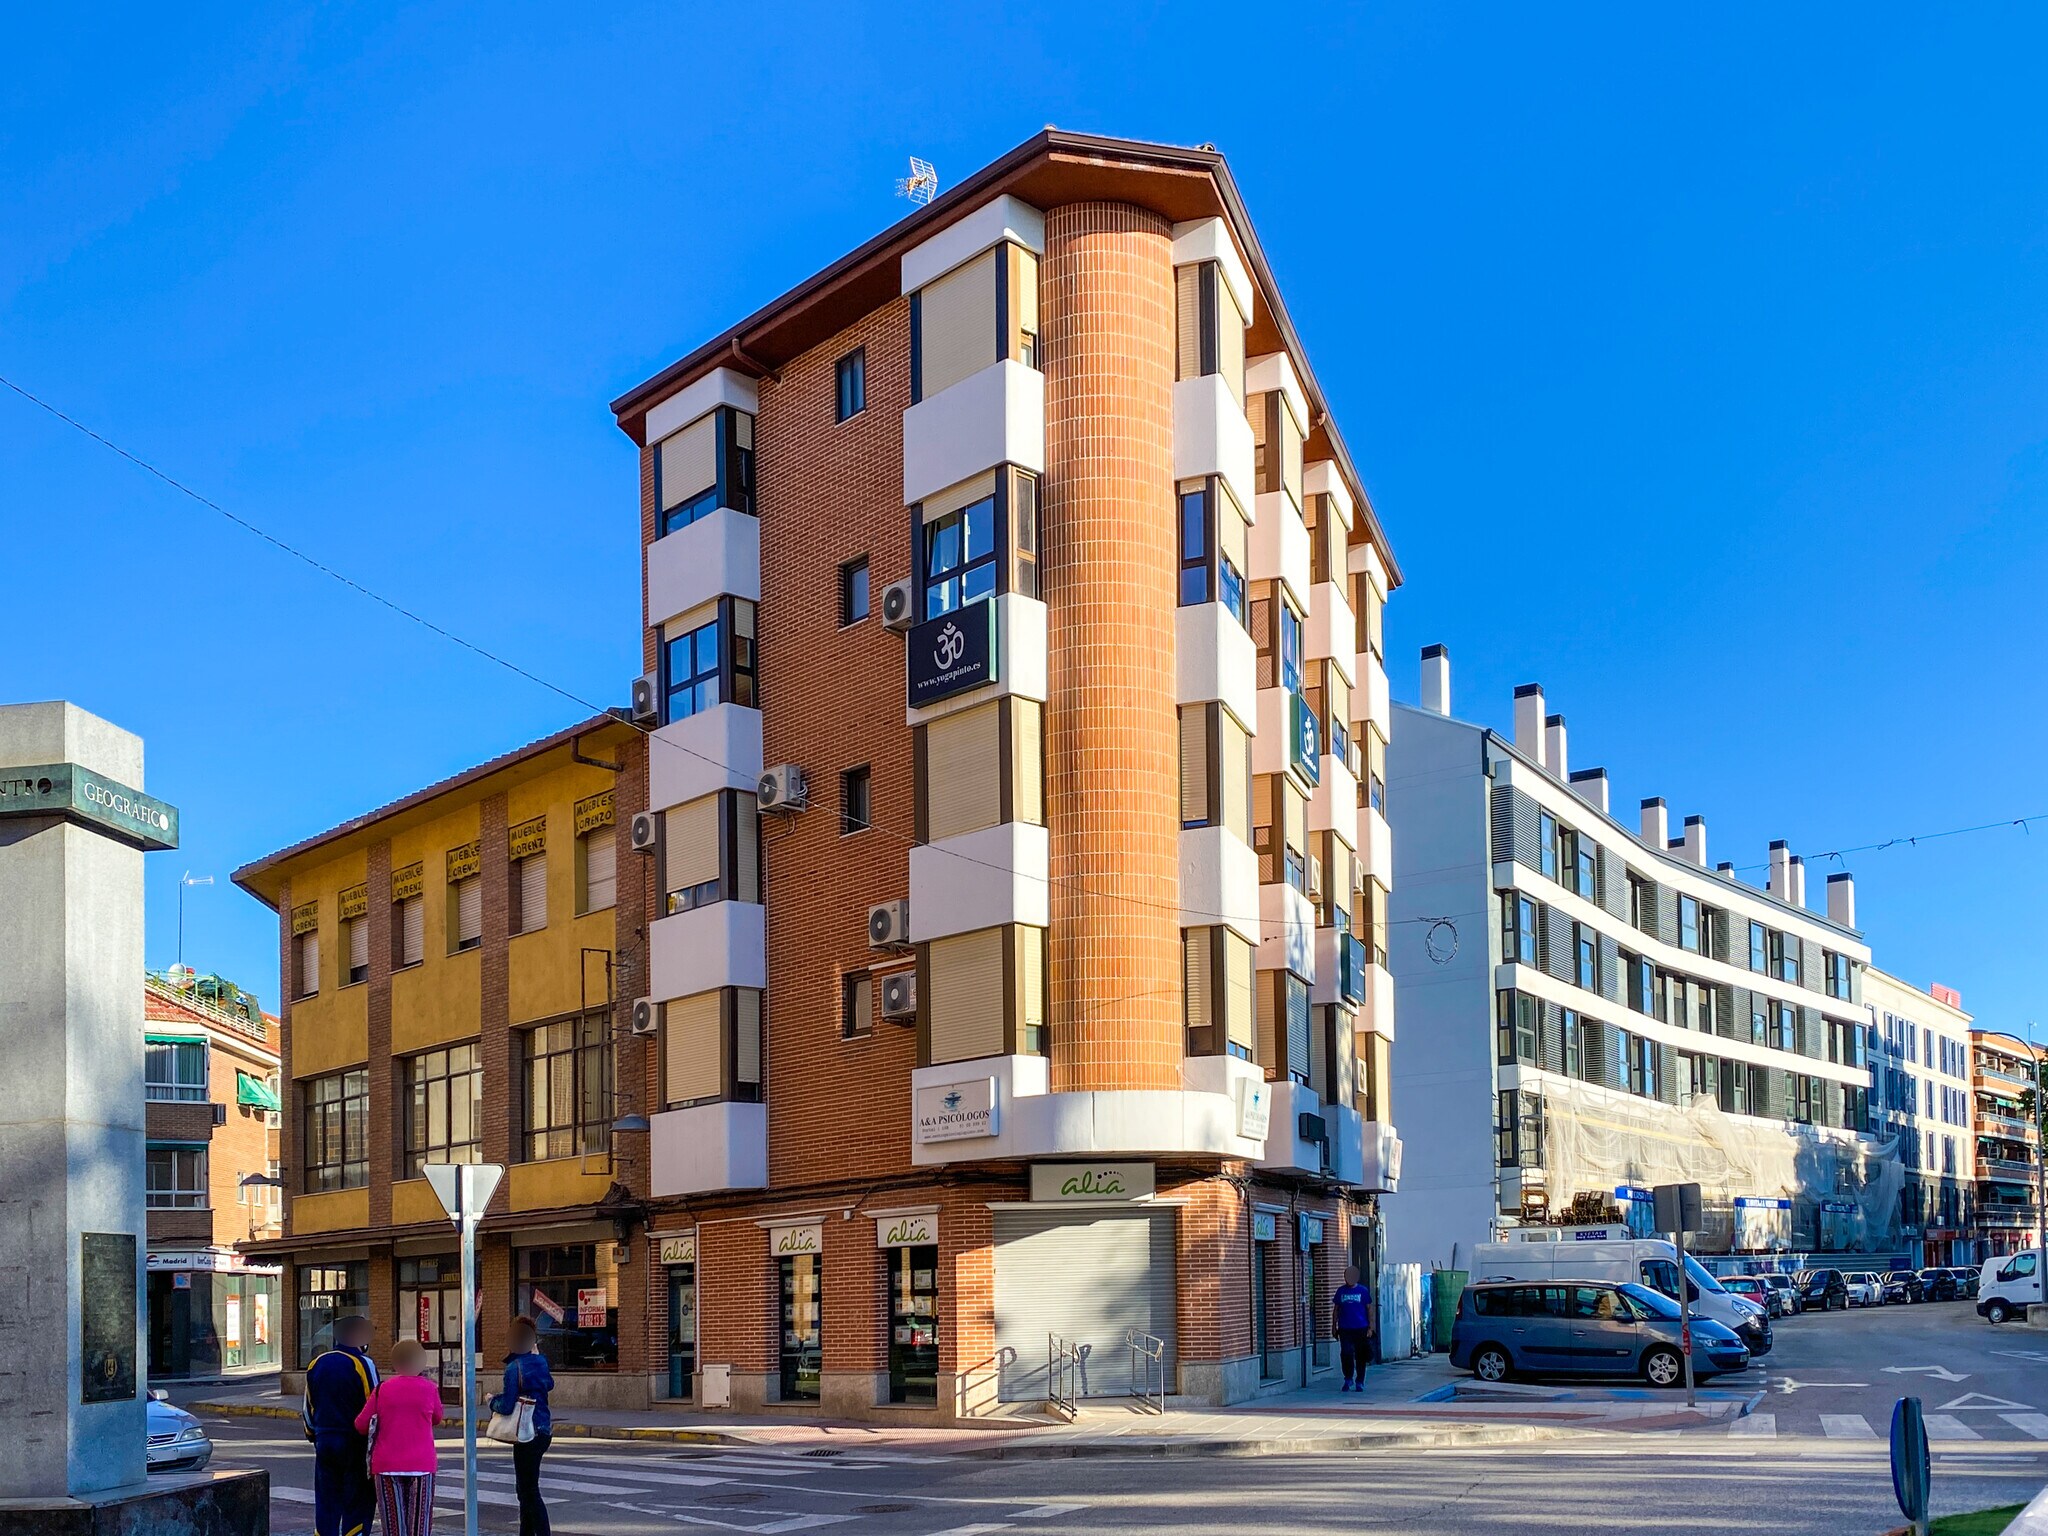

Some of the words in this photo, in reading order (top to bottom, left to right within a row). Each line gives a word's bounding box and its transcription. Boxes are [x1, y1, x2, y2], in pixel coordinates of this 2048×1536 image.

[917, 661, 981, 689] www.yogapinto.es
[576, 794, 614, 817] MUEBLES
[511, 820, 546, 841] MUEBLES
[576, 810, 612, 832] LORENZO
[510, 837, 546, 856] LORENZ
[919, 1116, 937, 1127] A&A
[938, 1109, 990, 1125] PSICÓLOGOS
[1061, 1170, 1125, 1196] alia
[779, 1229, 817, 1253] alia
[887, 1219, 930, 1245] alia
[663, 1239, 694, 1262] alia
[1341, 1293, 1362, 1303] LONDON
